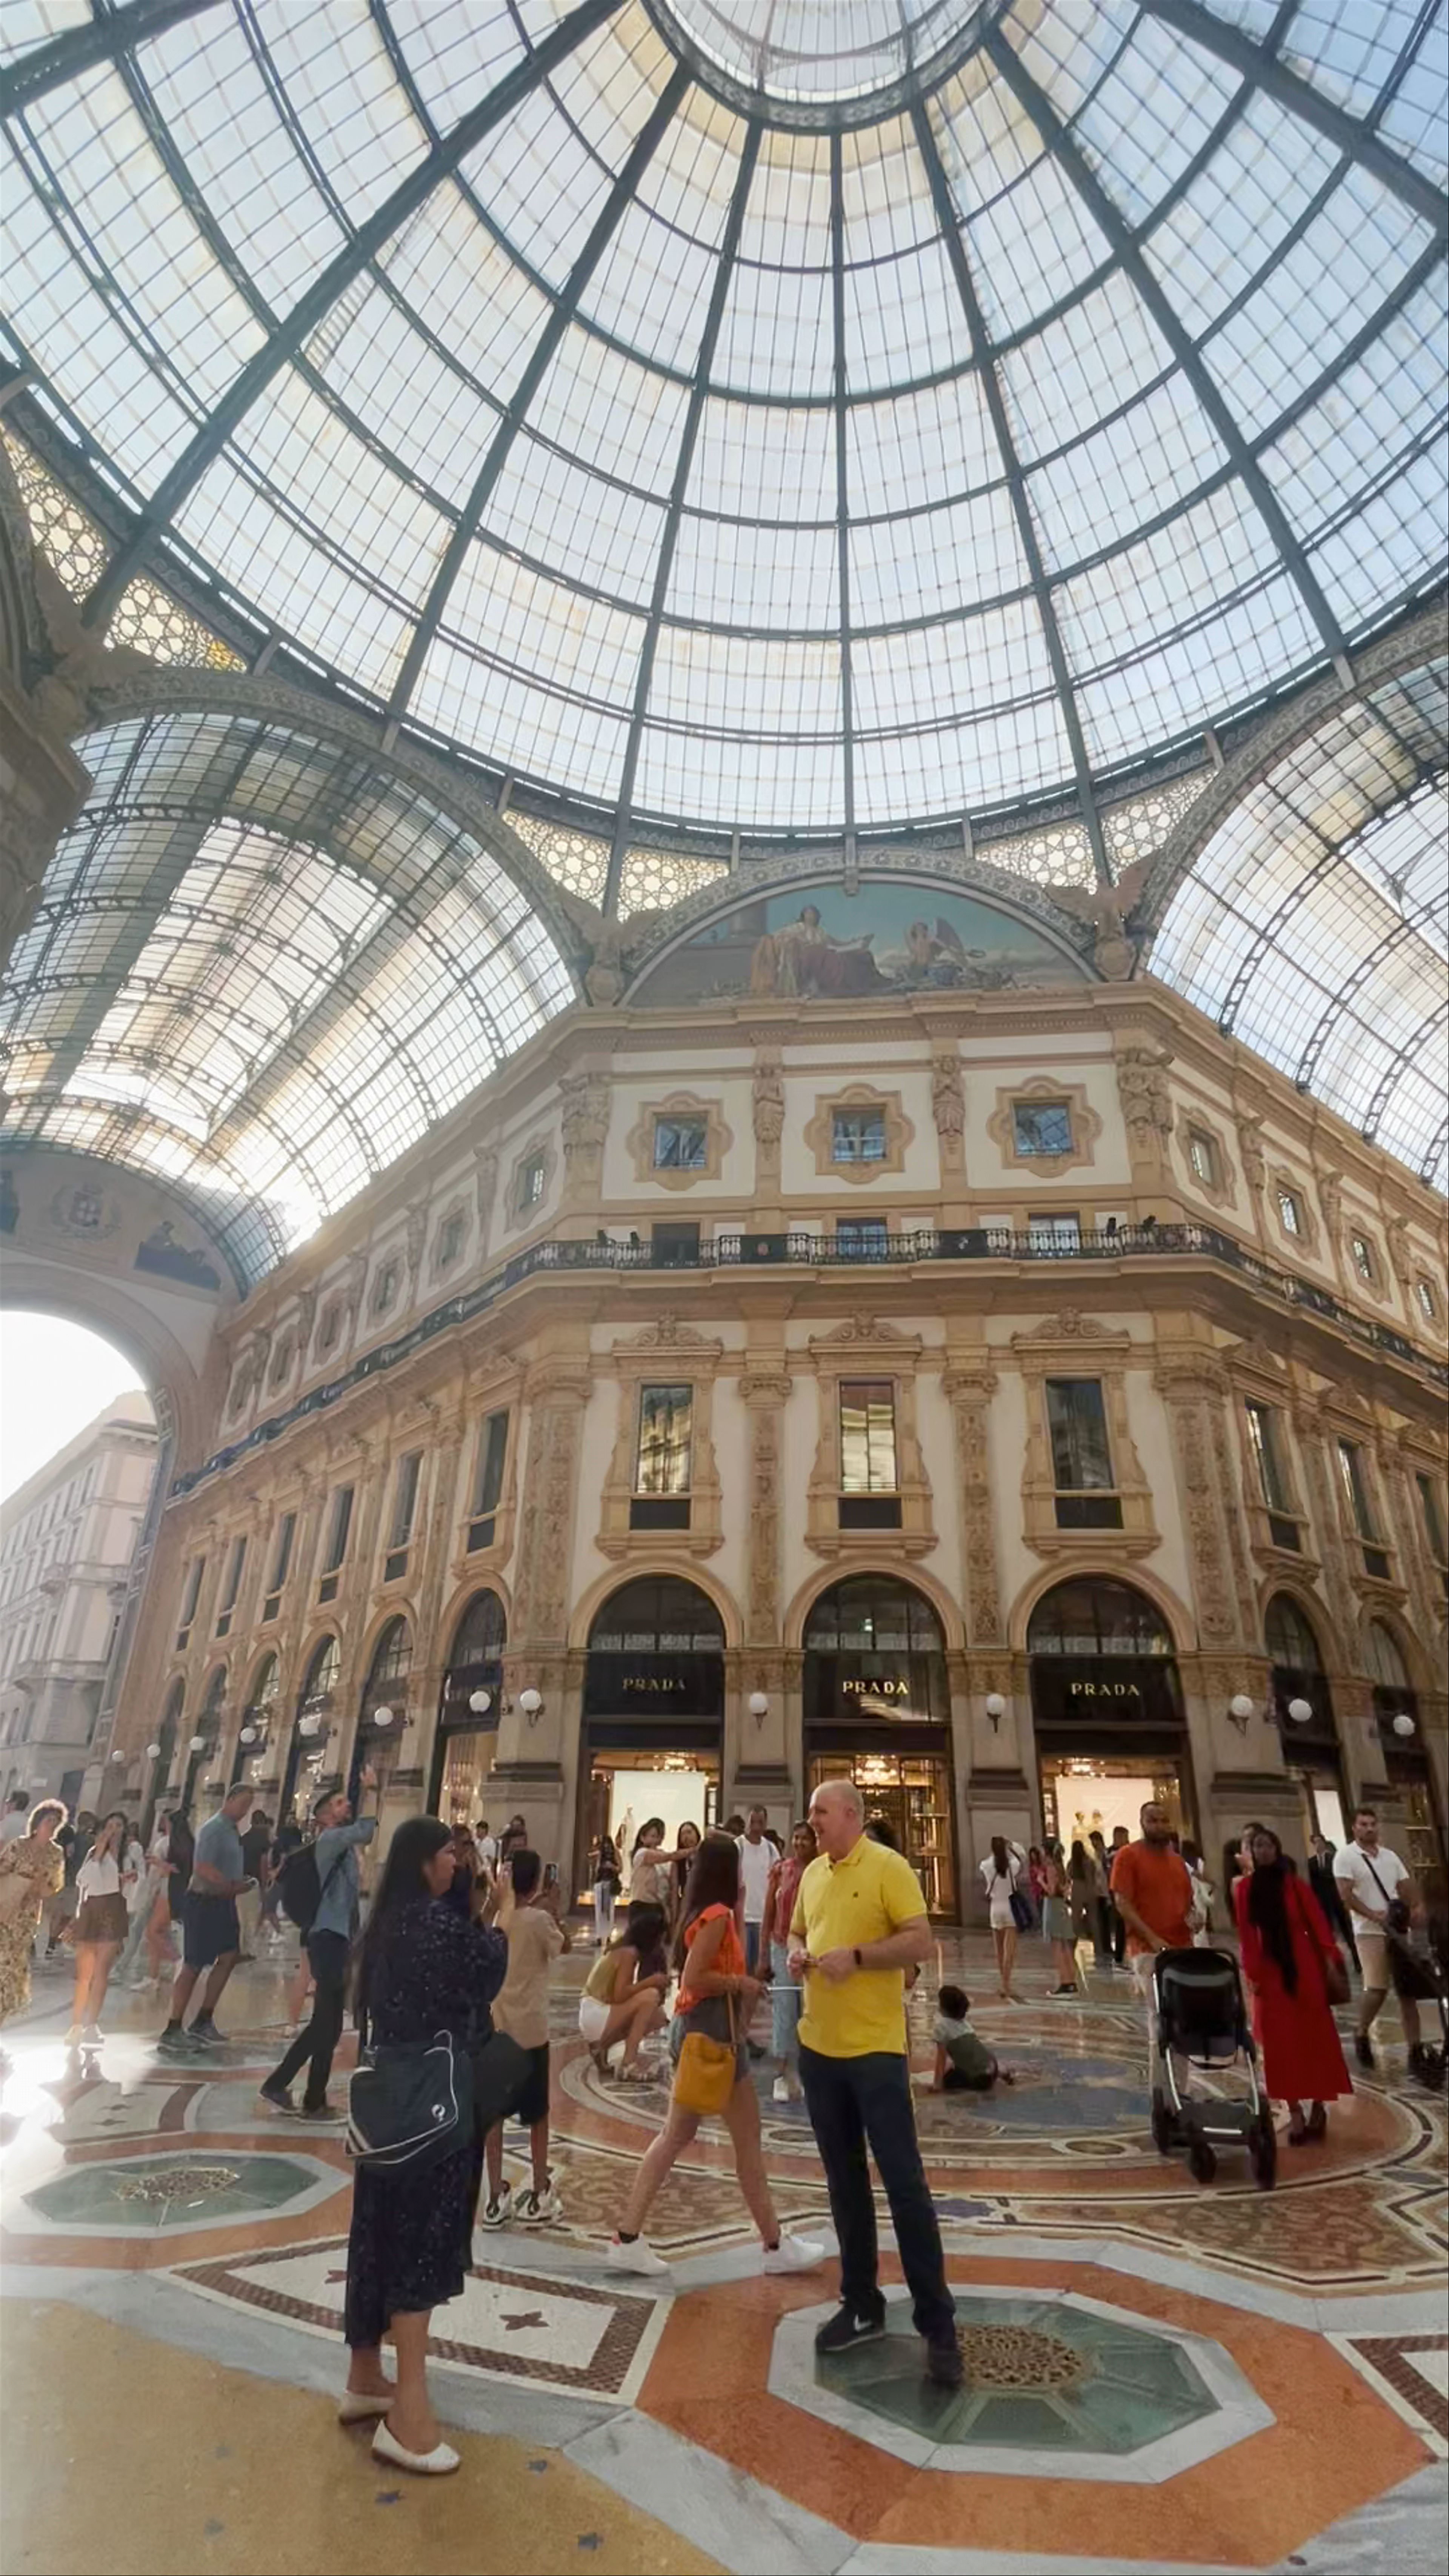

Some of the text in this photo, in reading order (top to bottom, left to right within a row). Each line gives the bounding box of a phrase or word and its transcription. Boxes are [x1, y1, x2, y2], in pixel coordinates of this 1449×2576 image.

[623, 1678, 686, 1690] PRADA
[843, 1681, 908, 1694] PRADA
[1071, 1683, 1140, 1696] PRADA
